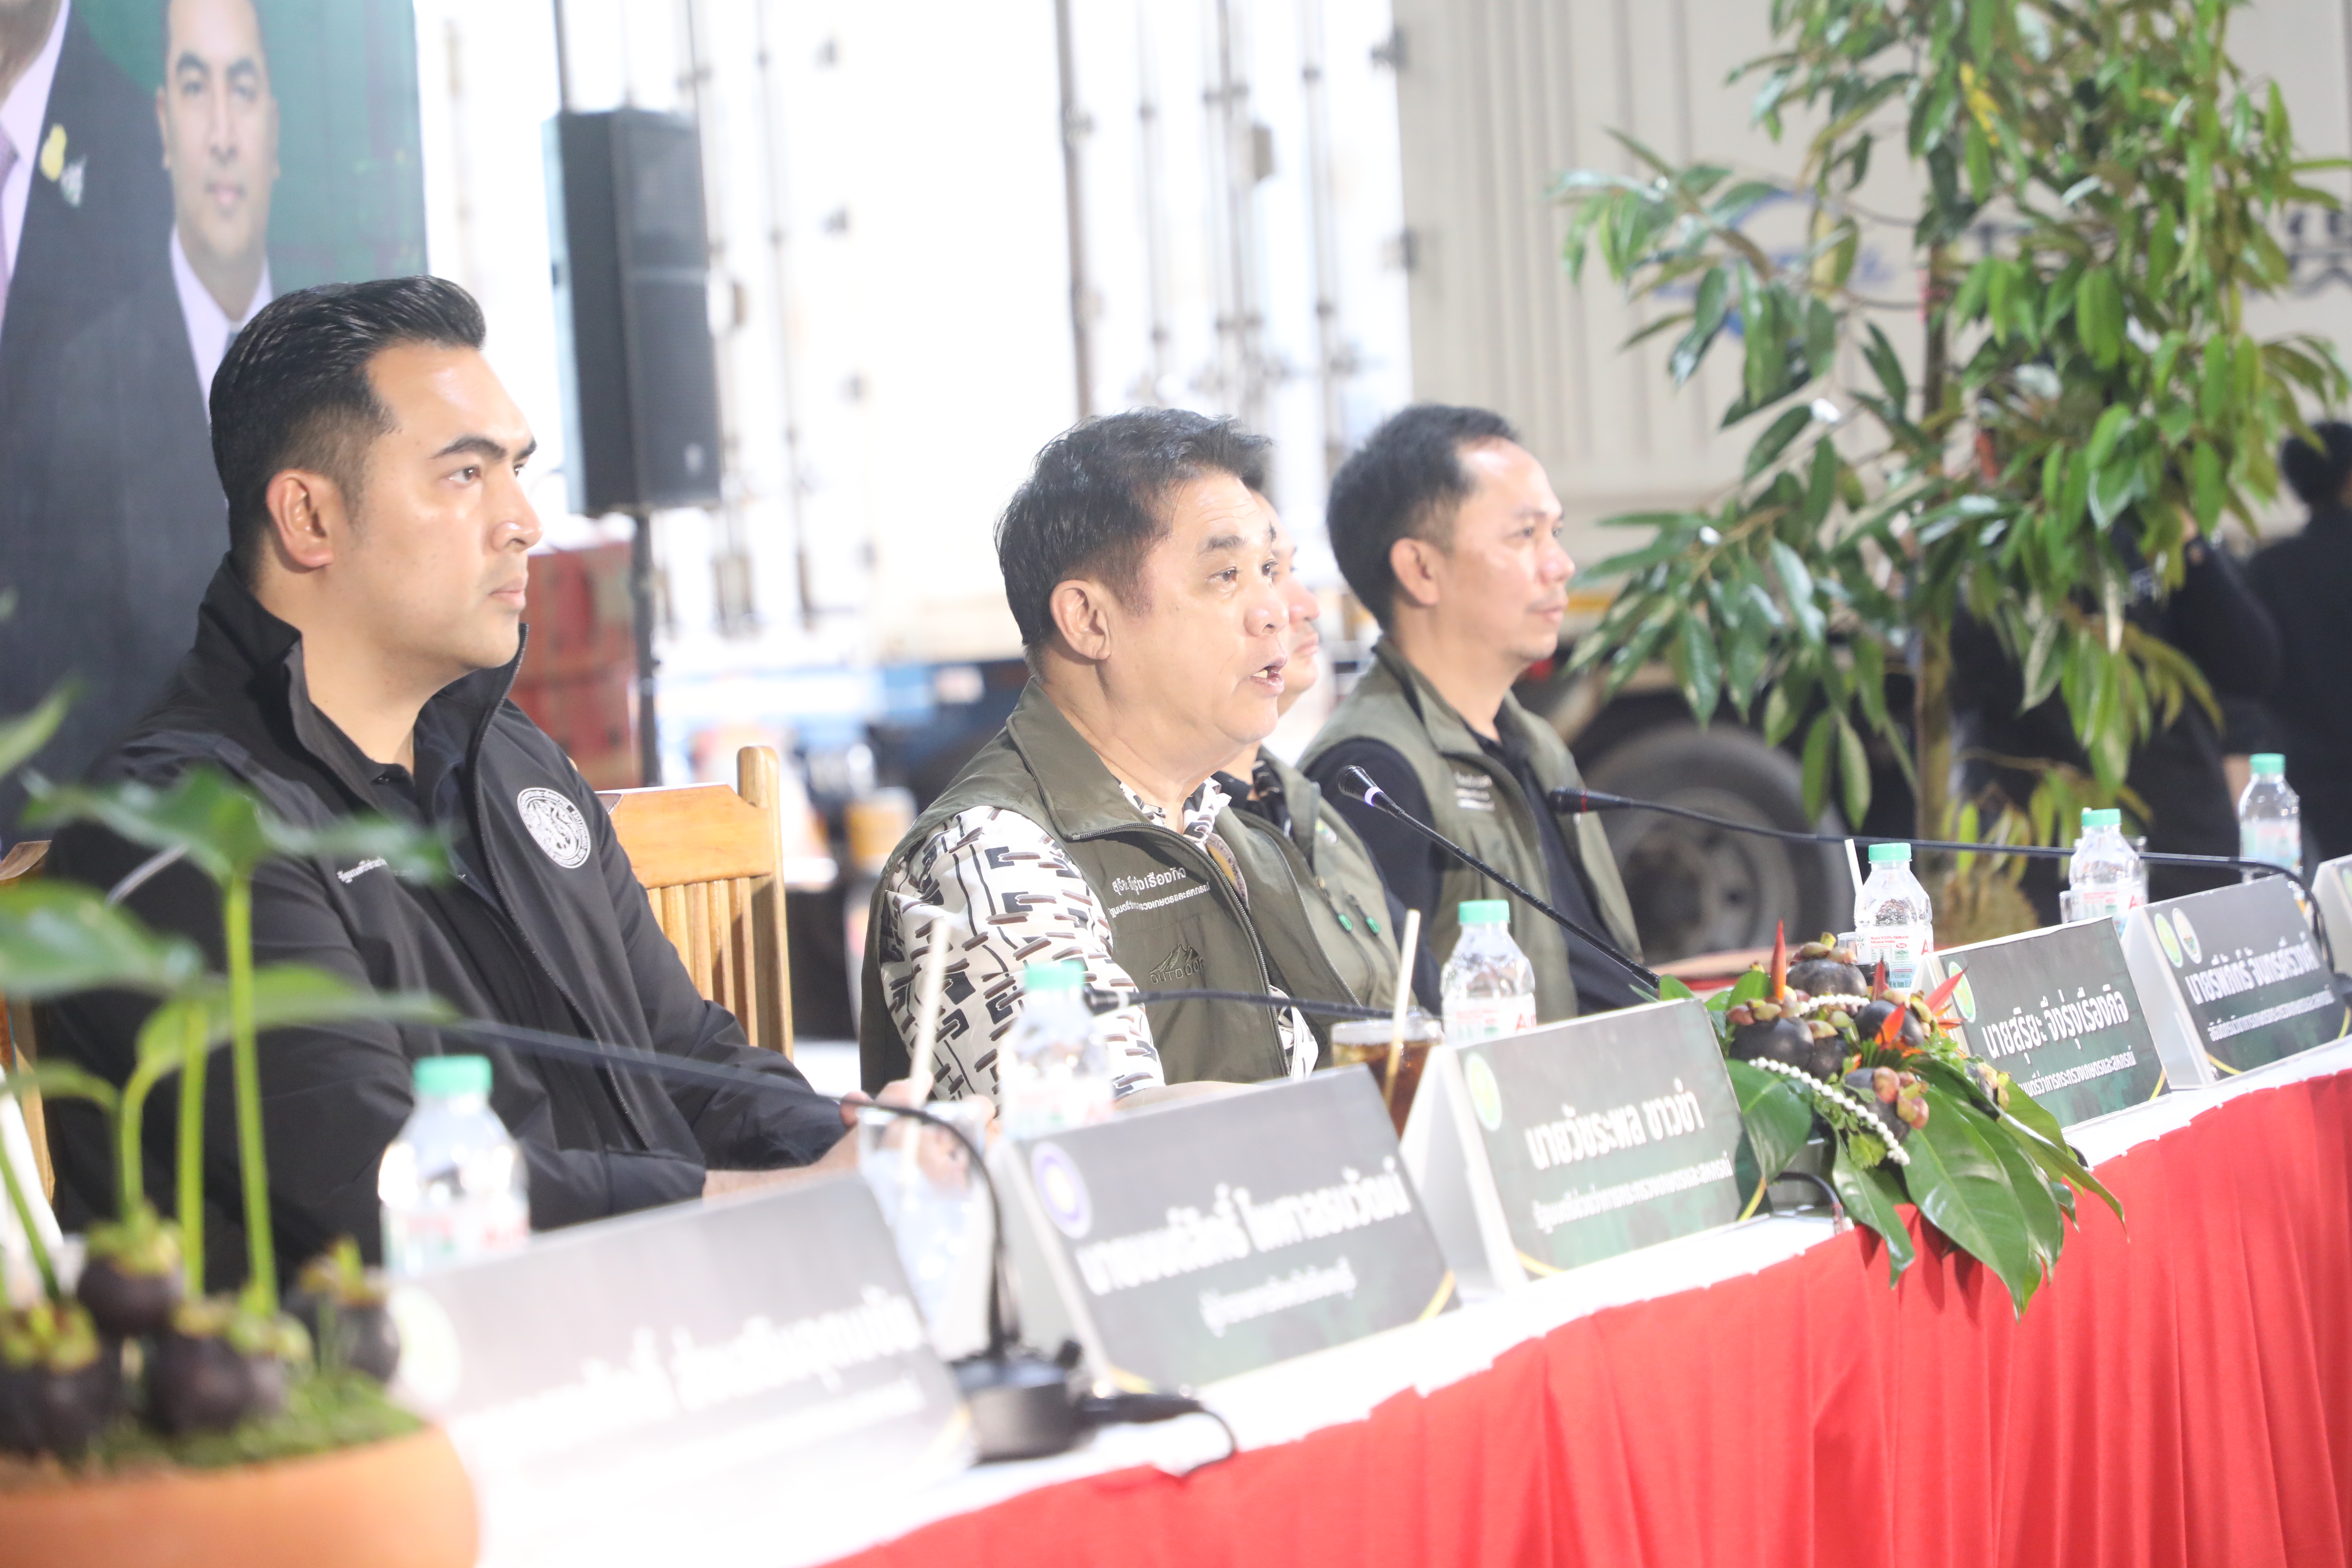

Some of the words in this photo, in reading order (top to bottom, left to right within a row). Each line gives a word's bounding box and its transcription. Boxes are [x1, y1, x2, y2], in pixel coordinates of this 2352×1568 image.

[1150, 957, 1204, 984] OUTDOOR
[1982, 1007, 2048, 1064] นายสุริยะ
[2040, 984, 2130, 1050] จึงรุ่งเรืองกิจ
[2017, 1045, 2138, 1097] มนตรีว่าการกระทรวงเกษตรและสหกรณ์
[1524, 1103, 1647, 1170] นายวัชระพล
[1642, 1077, 1706, 1141] ขาวขำ
